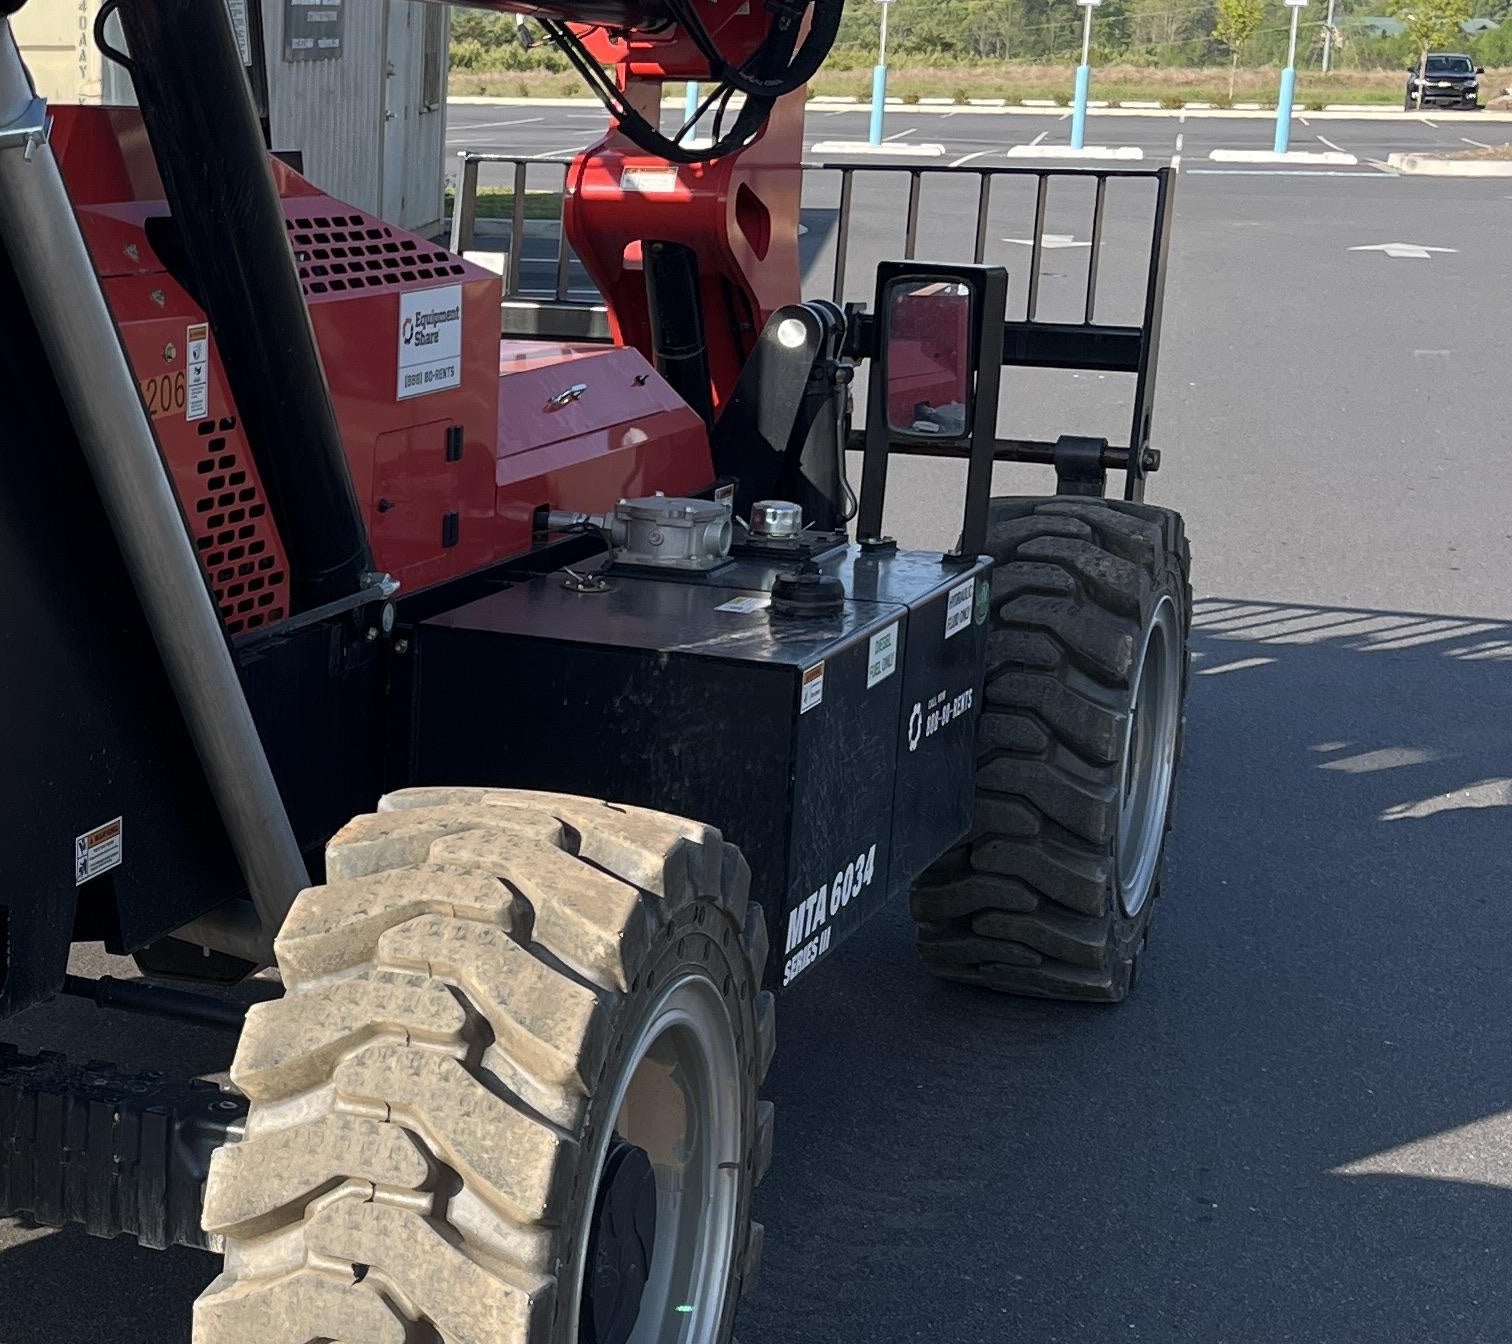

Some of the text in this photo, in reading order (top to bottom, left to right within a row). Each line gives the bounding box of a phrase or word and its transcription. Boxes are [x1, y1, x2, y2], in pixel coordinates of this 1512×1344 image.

[415, 305, 459, 330] Equipment
[414, 331, 439, 347] Share
[139, 371, 185, 415] 206
[875, 633, 891, 655] DIESEL
[869, 652, 895, 678] FUEL ONLY
[785, 843, 876, 955] MTA 6034
[783, 936, 819, 987] SERIES
